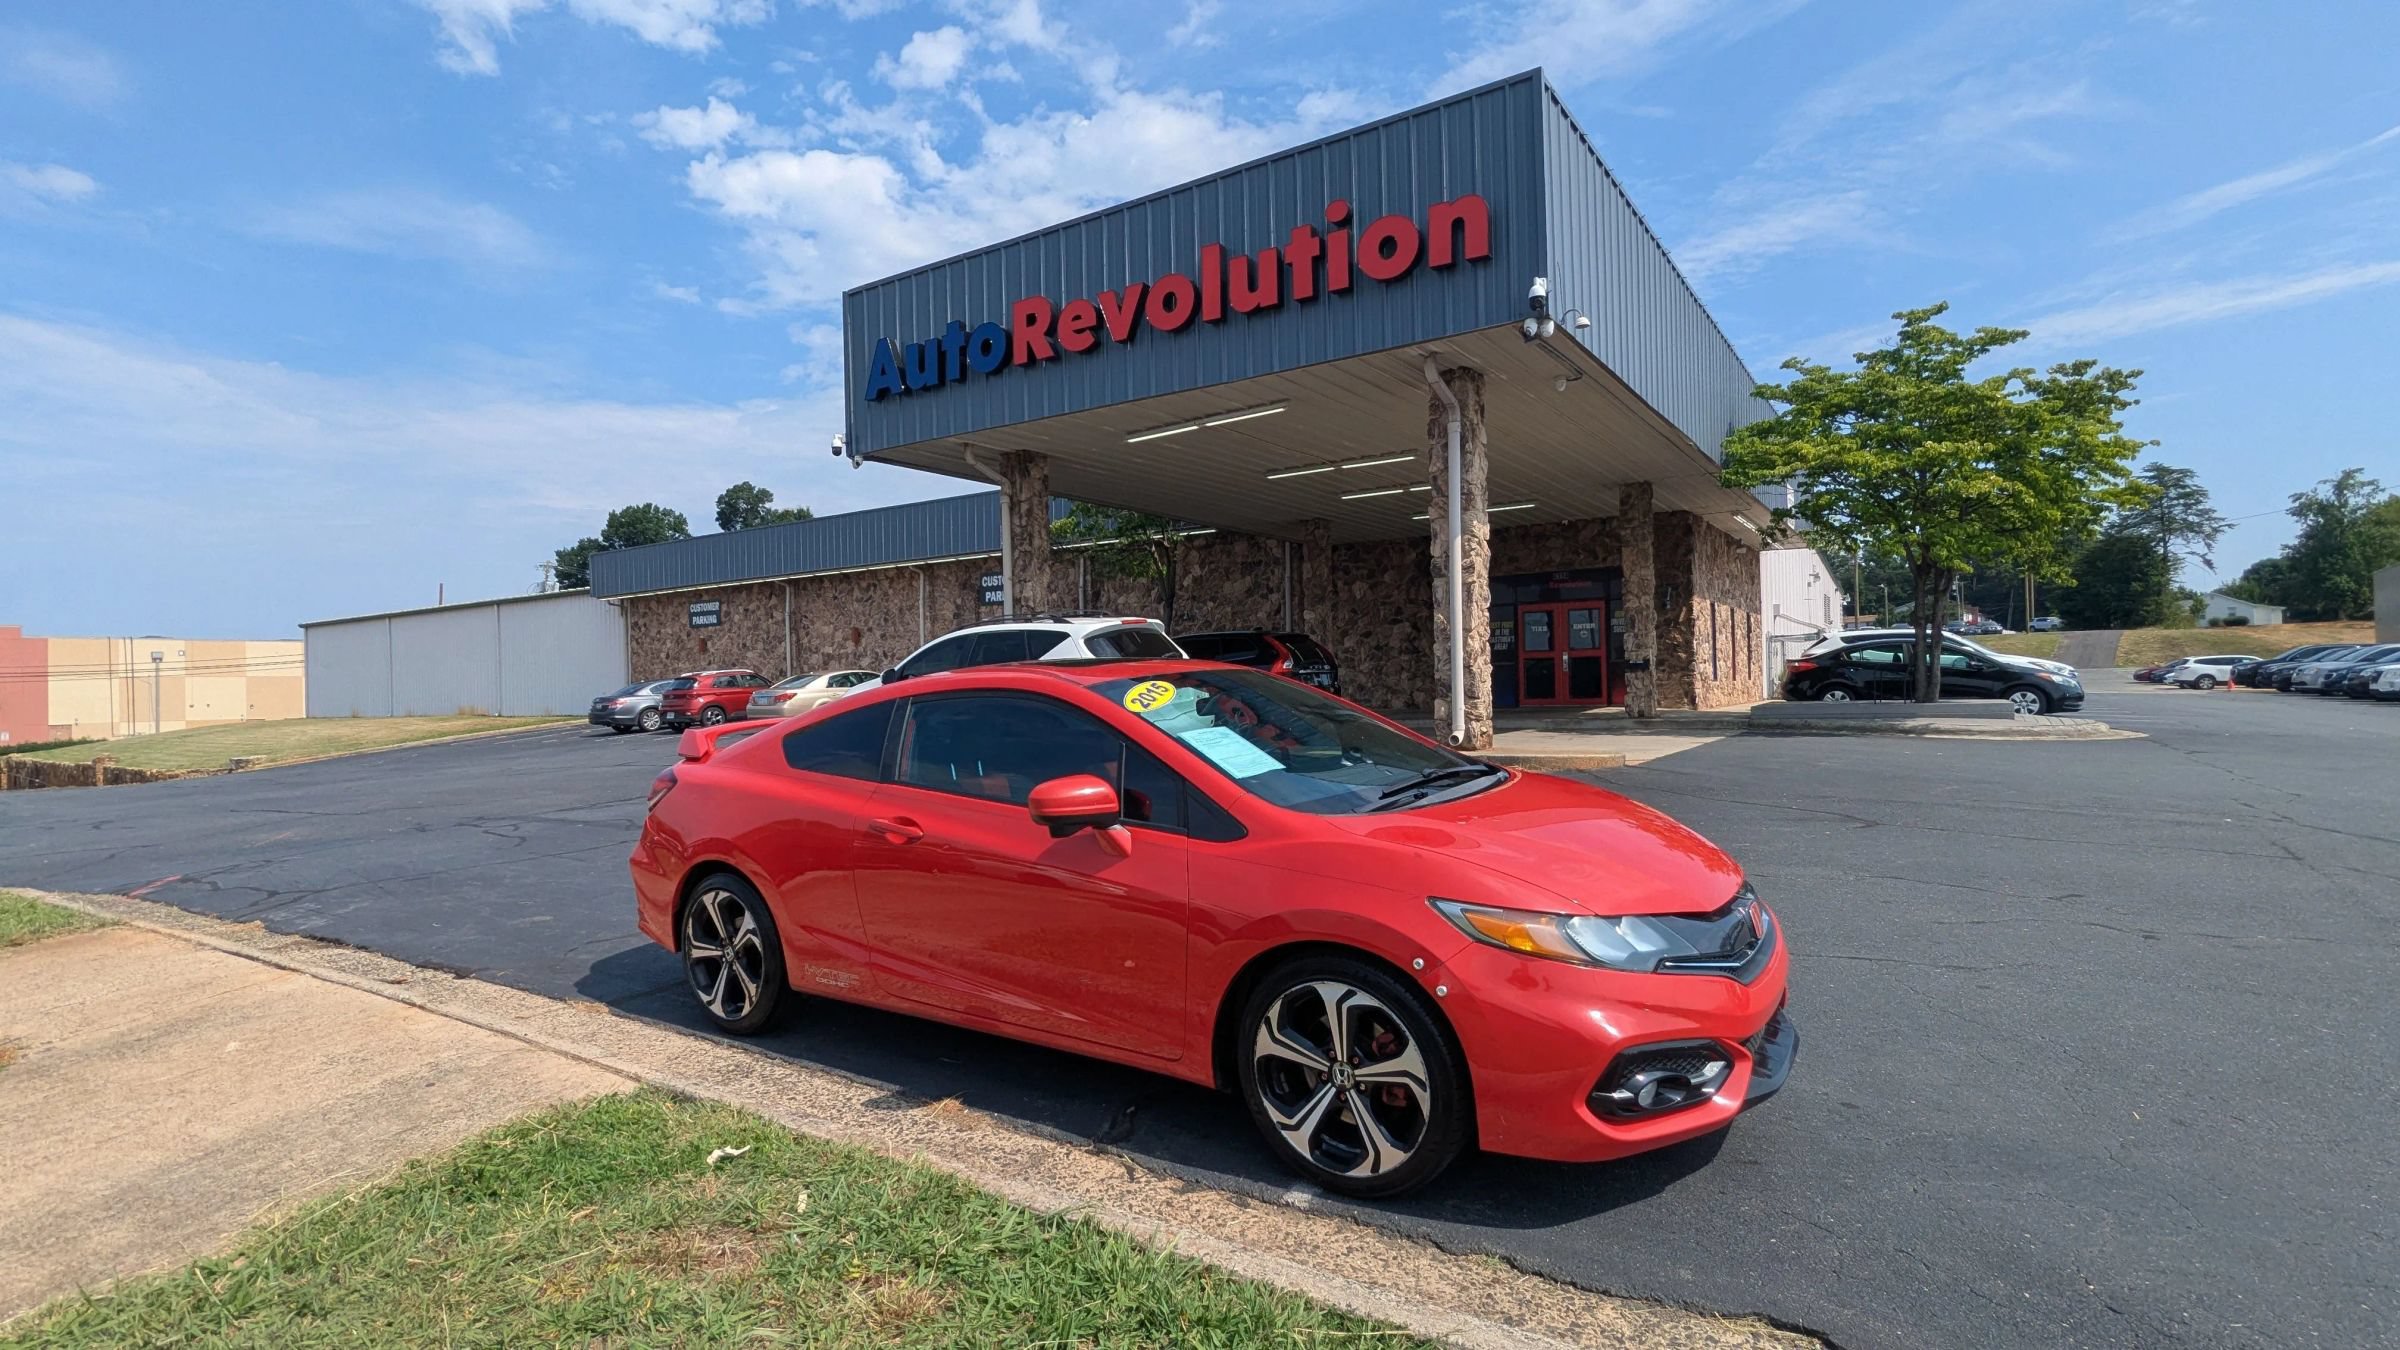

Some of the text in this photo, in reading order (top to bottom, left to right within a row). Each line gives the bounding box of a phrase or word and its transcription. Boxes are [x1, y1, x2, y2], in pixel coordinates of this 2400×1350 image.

[690, 601, 719, 613] CUSTOMER
[692, 615, 717, 625] PARKING
[1130, 682, 1170, 709] 2015
